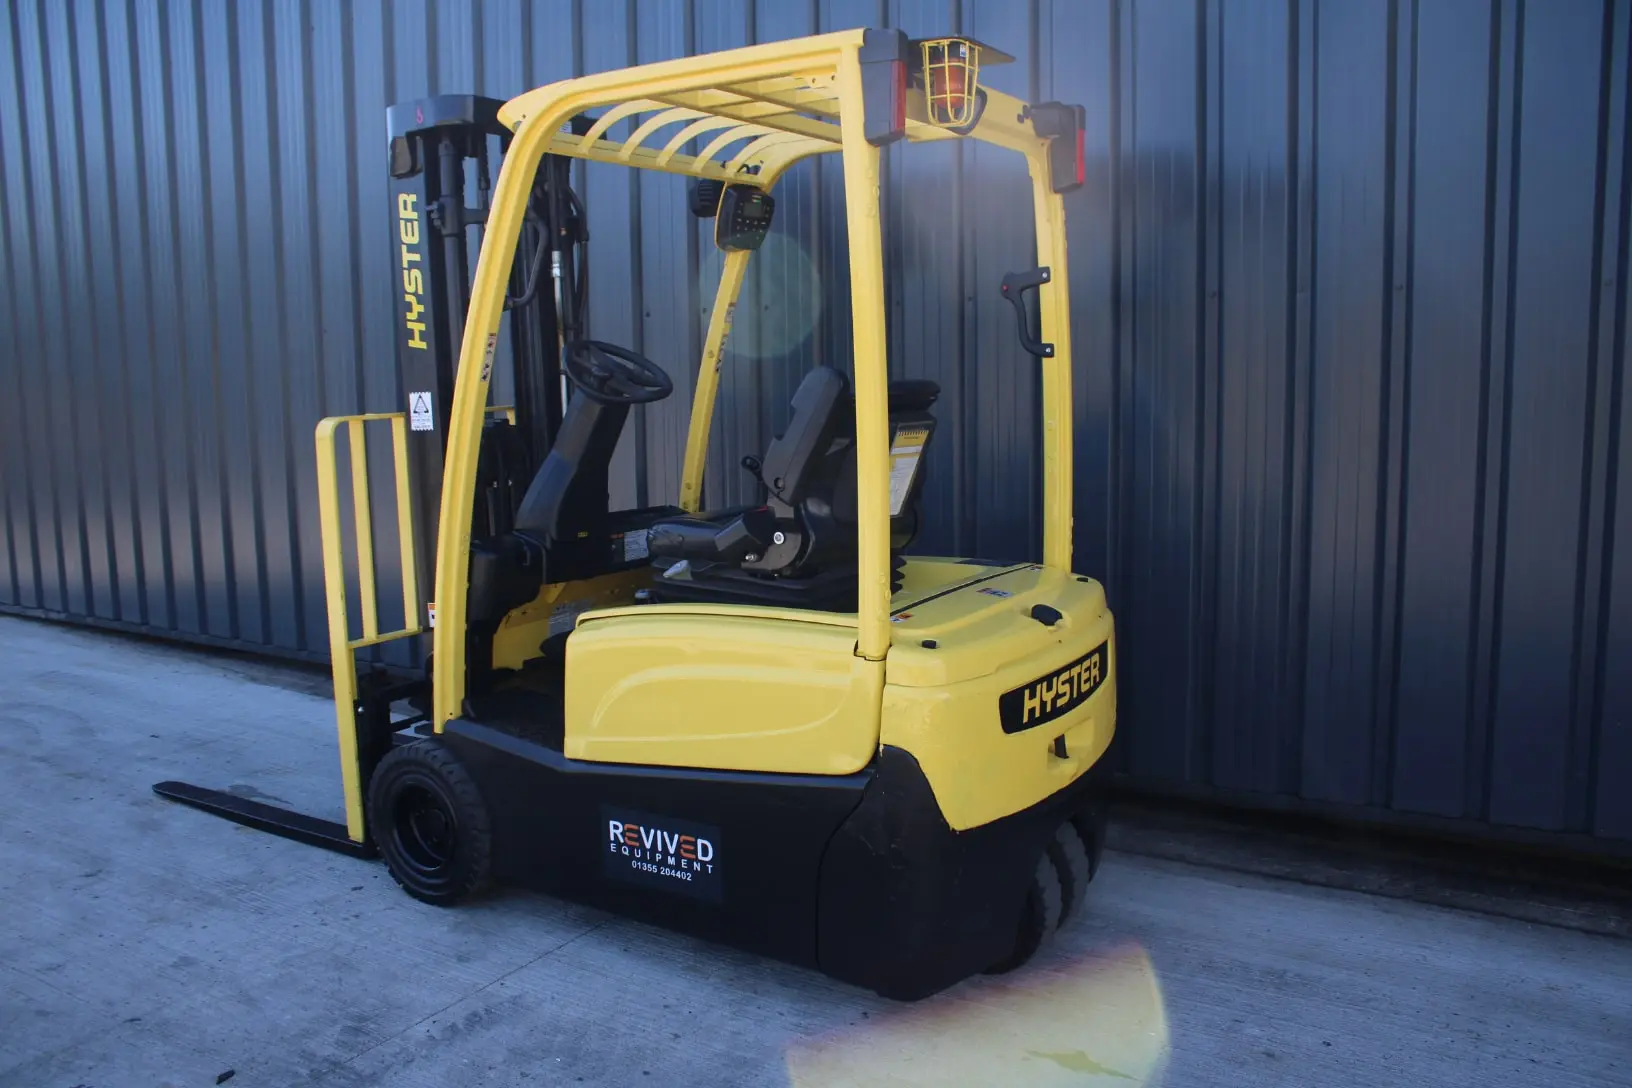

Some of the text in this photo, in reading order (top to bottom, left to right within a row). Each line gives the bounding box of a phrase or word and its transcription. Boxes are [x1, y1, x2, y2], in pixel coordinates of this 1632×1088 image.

[398, 193, 427, 349] HYSTER
[1023, 653, 1100, 724] HYSTER
[609, 820, 713, 861] REVIVED
[610, 843, 713, 874] EQUIPMENT
[631, 860, 692, 881] 01355 204402
